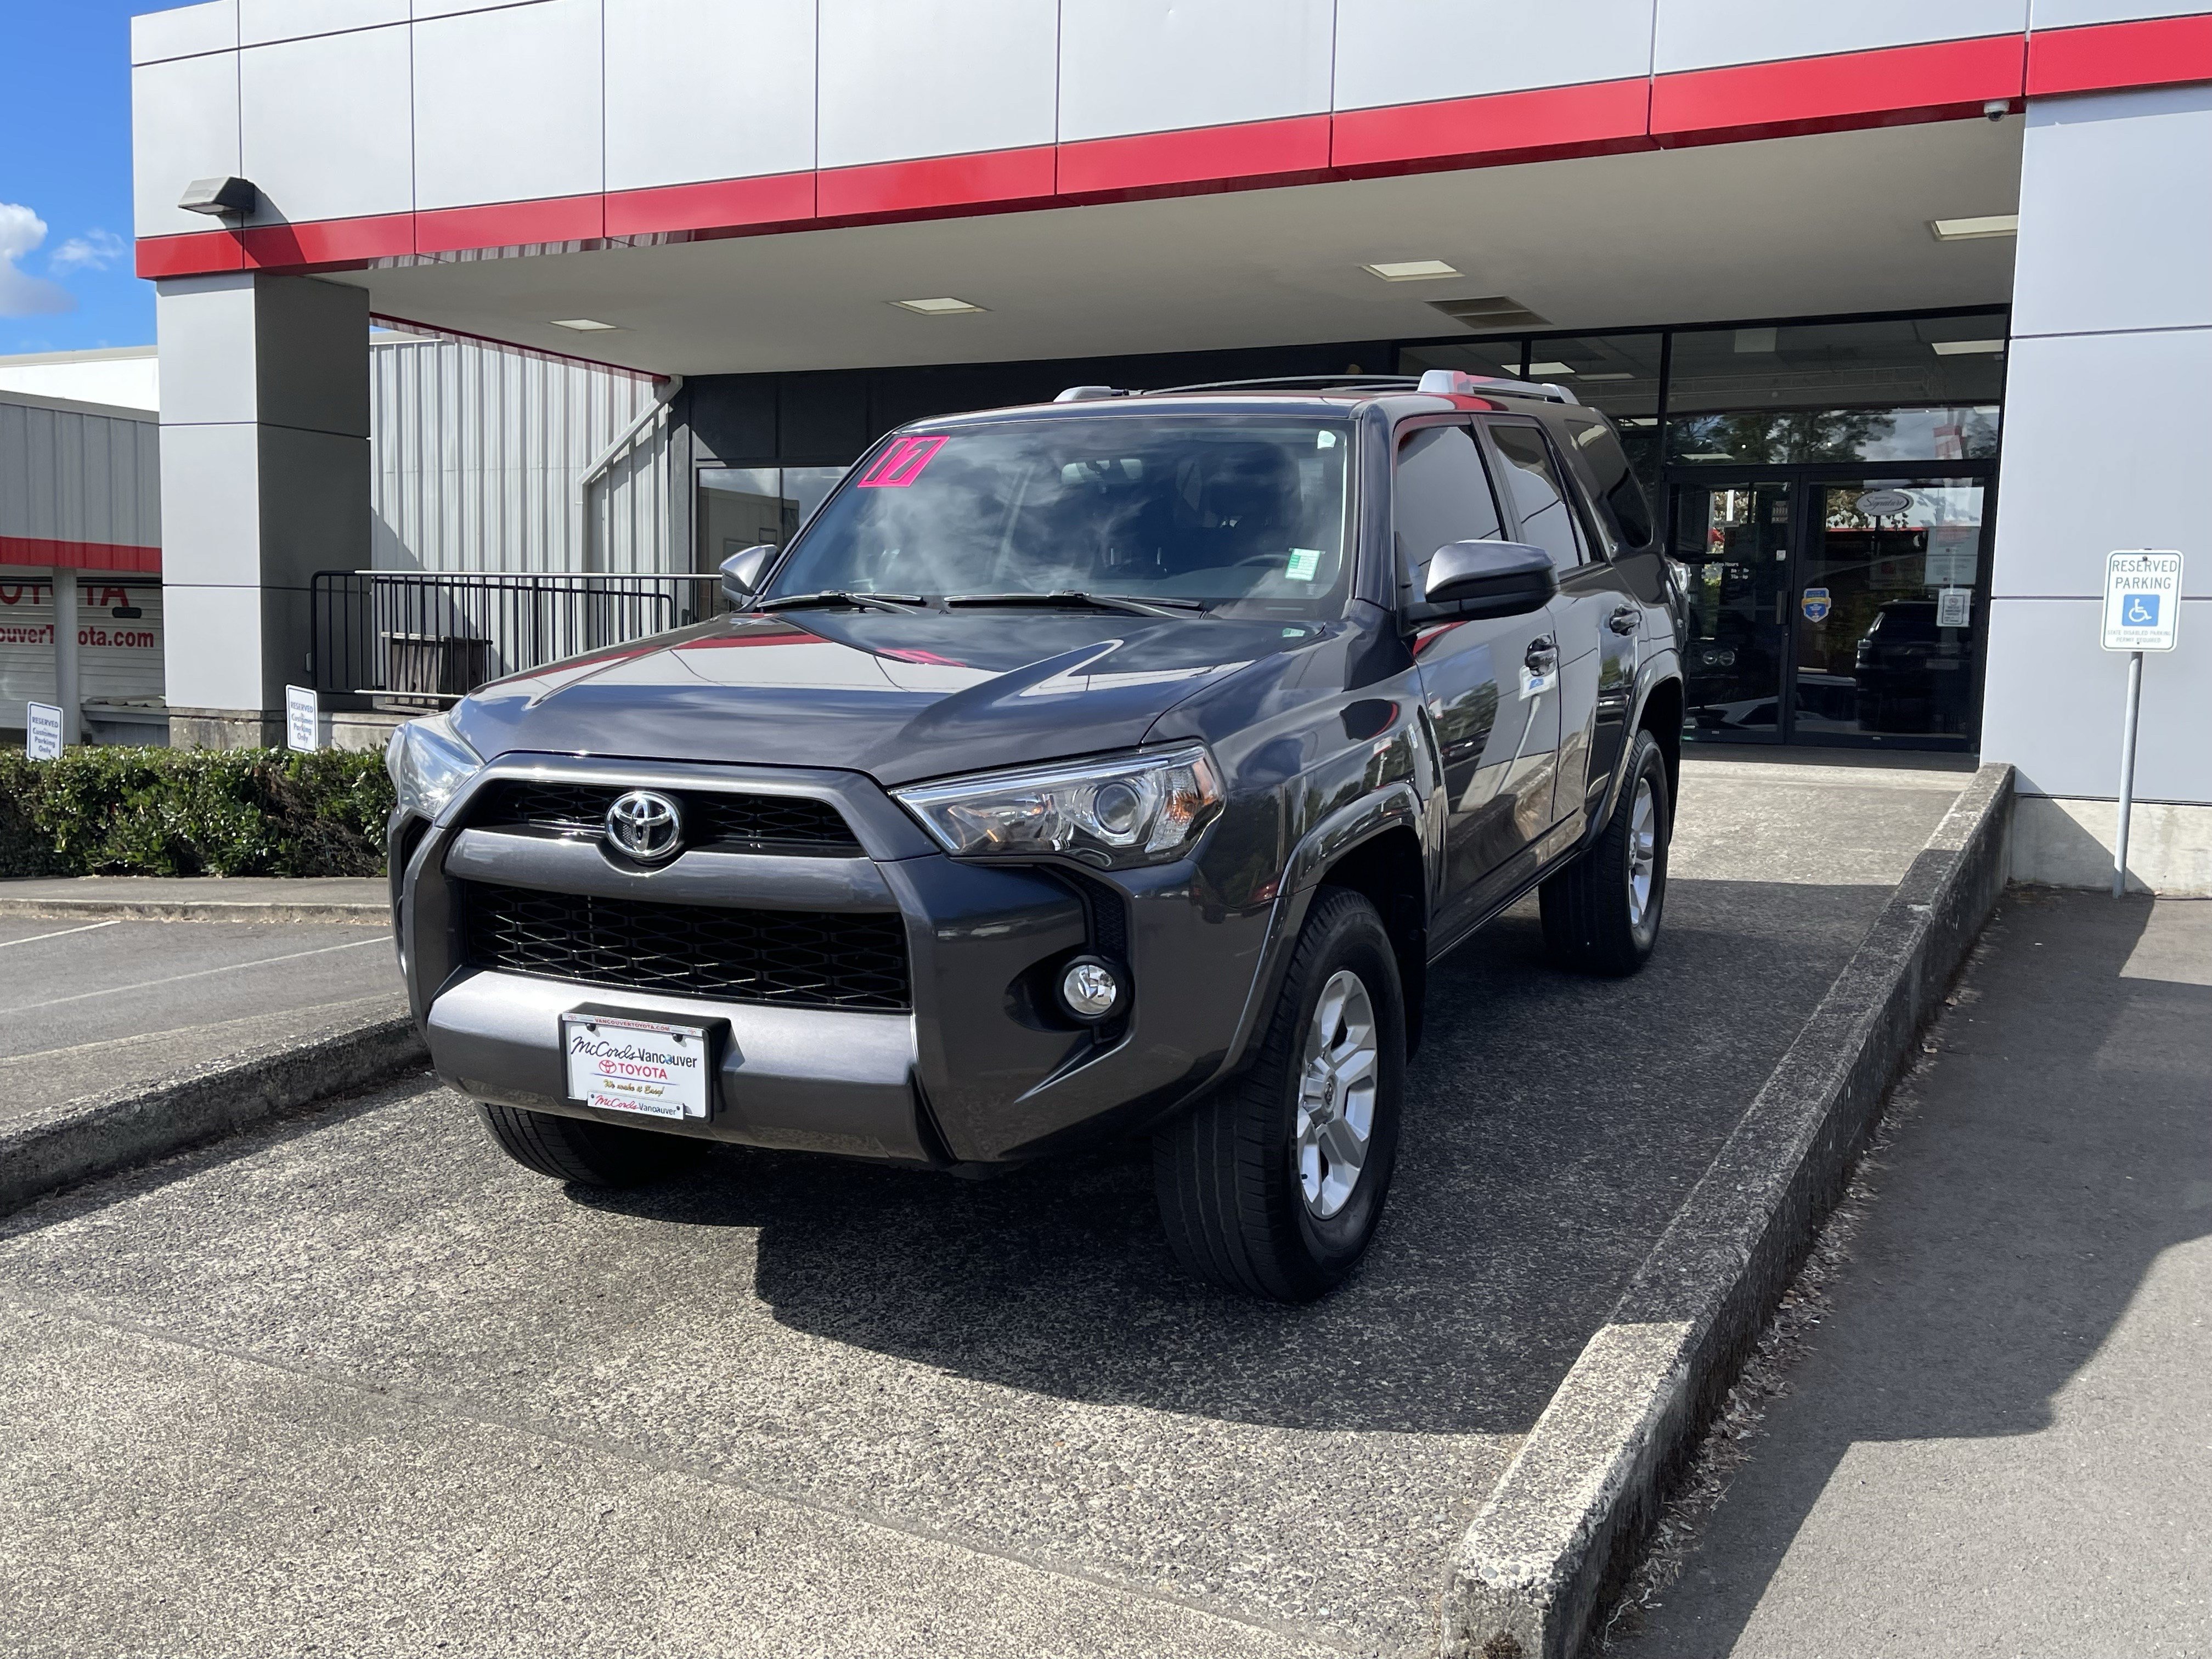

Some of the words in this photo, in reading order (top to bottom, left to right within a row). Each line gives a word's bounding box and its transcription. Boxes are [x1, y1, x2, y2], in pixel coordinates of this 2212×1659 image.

[864, 439, 943, 482] 17
[2112, 560, 2177, 572] RESERVED
[2115, 577, 2171, 589] PARKING
[290, 702, 313, 713] RESERVED
[32, 716, 59, 728] RESERVED
[294, 723, 312, 736] Parking
[35, 736, 55, 748] Parking
[594, 1018, 670, 1031] VANCOUVERTOYOTA.COM
[618, 1063, 668, 1080] TOYOTA
